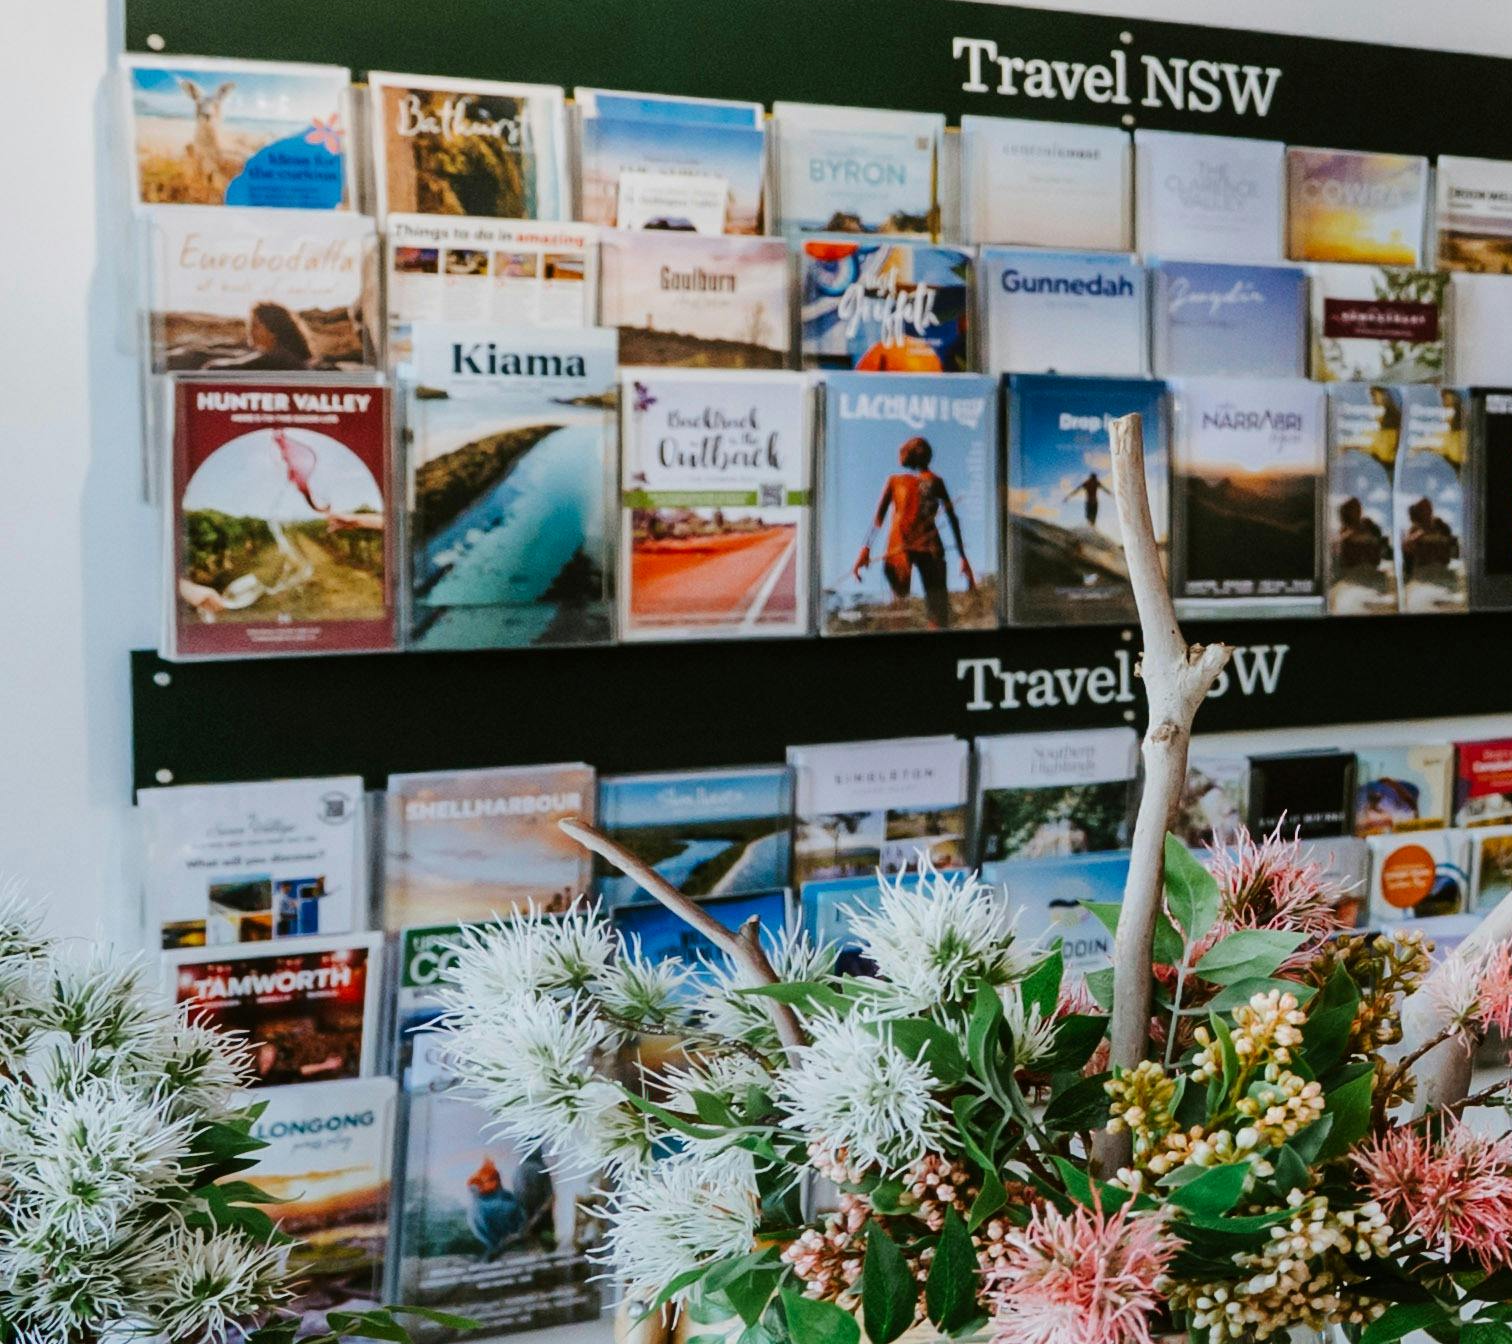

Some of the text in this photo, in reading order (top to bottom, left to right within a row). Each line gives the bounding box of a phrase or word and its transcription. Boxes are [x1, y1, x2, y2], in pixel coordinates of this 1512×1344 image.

[952, 34, 1283, 119] Travel NSW
[808, 158, 908, 187] BYRON
[178, 233, 355, 273] Eurobodalla
[660, 264, 737, 294] Goulburn
[1001, 268, 1134, 298] Gunnedah
[452, 342, 587, 378] Kiama
[196, 391, 372, 413] HUNTER VALLEY
[658, 431, 785, 472] Outback
[956, 649, 1136, 711] Travel
[404, 792, 582, 821] SHELLHARBOUR
[193, 966, 352, 1001] TAMWORTH
